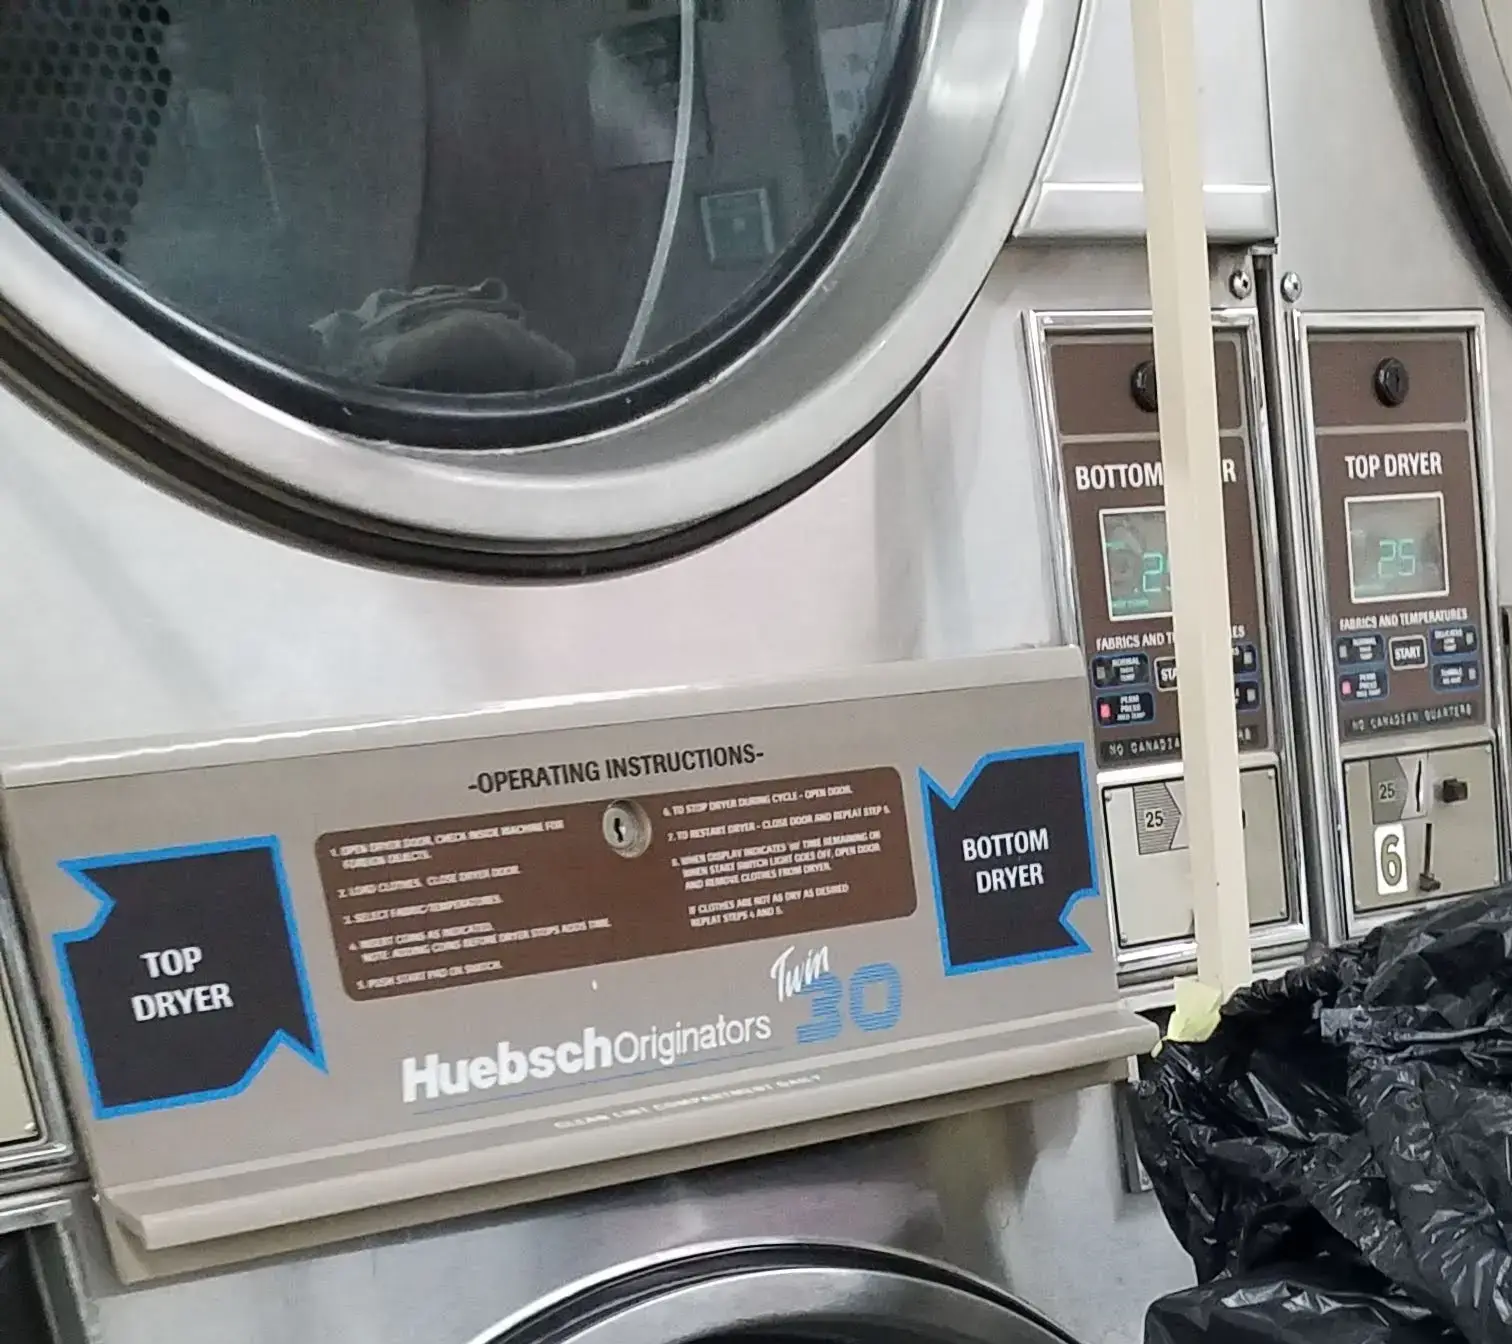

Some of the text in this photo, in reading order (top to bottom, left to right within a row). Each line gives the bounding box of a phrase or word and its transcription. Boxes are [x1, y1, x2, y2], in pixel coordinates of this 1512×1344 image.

[1074, 462, 1164, 490] BOTTOM
[1344, 451, 1442, 479] TOP DRYER
[1378, 539, 1416, 578] 25
[1339, 607, 1468, 631] FABRICS AND TEMPERATURES
[1096, 634, 1141, 651] FABRICS
[1142, 632, 1165, 646] AND
[1394, 646, 1421, 661] START
[1131, 737, 1180, 753] CANADIA
[1380, 784, 1395, 799] 25
[1145, 811, 1163, 828] 25
[962, 827, 1049, 861] BOTTOM
[1380, 834, 1403, 887] 6
[976, 862, 1044, 894] DRYER
[140, 947, 202, 978] TOP
[769, 944, 830, 1002] Twin
[131, 983, 234, 1022] DRYER
[795, 962, 903, 1044] 30
